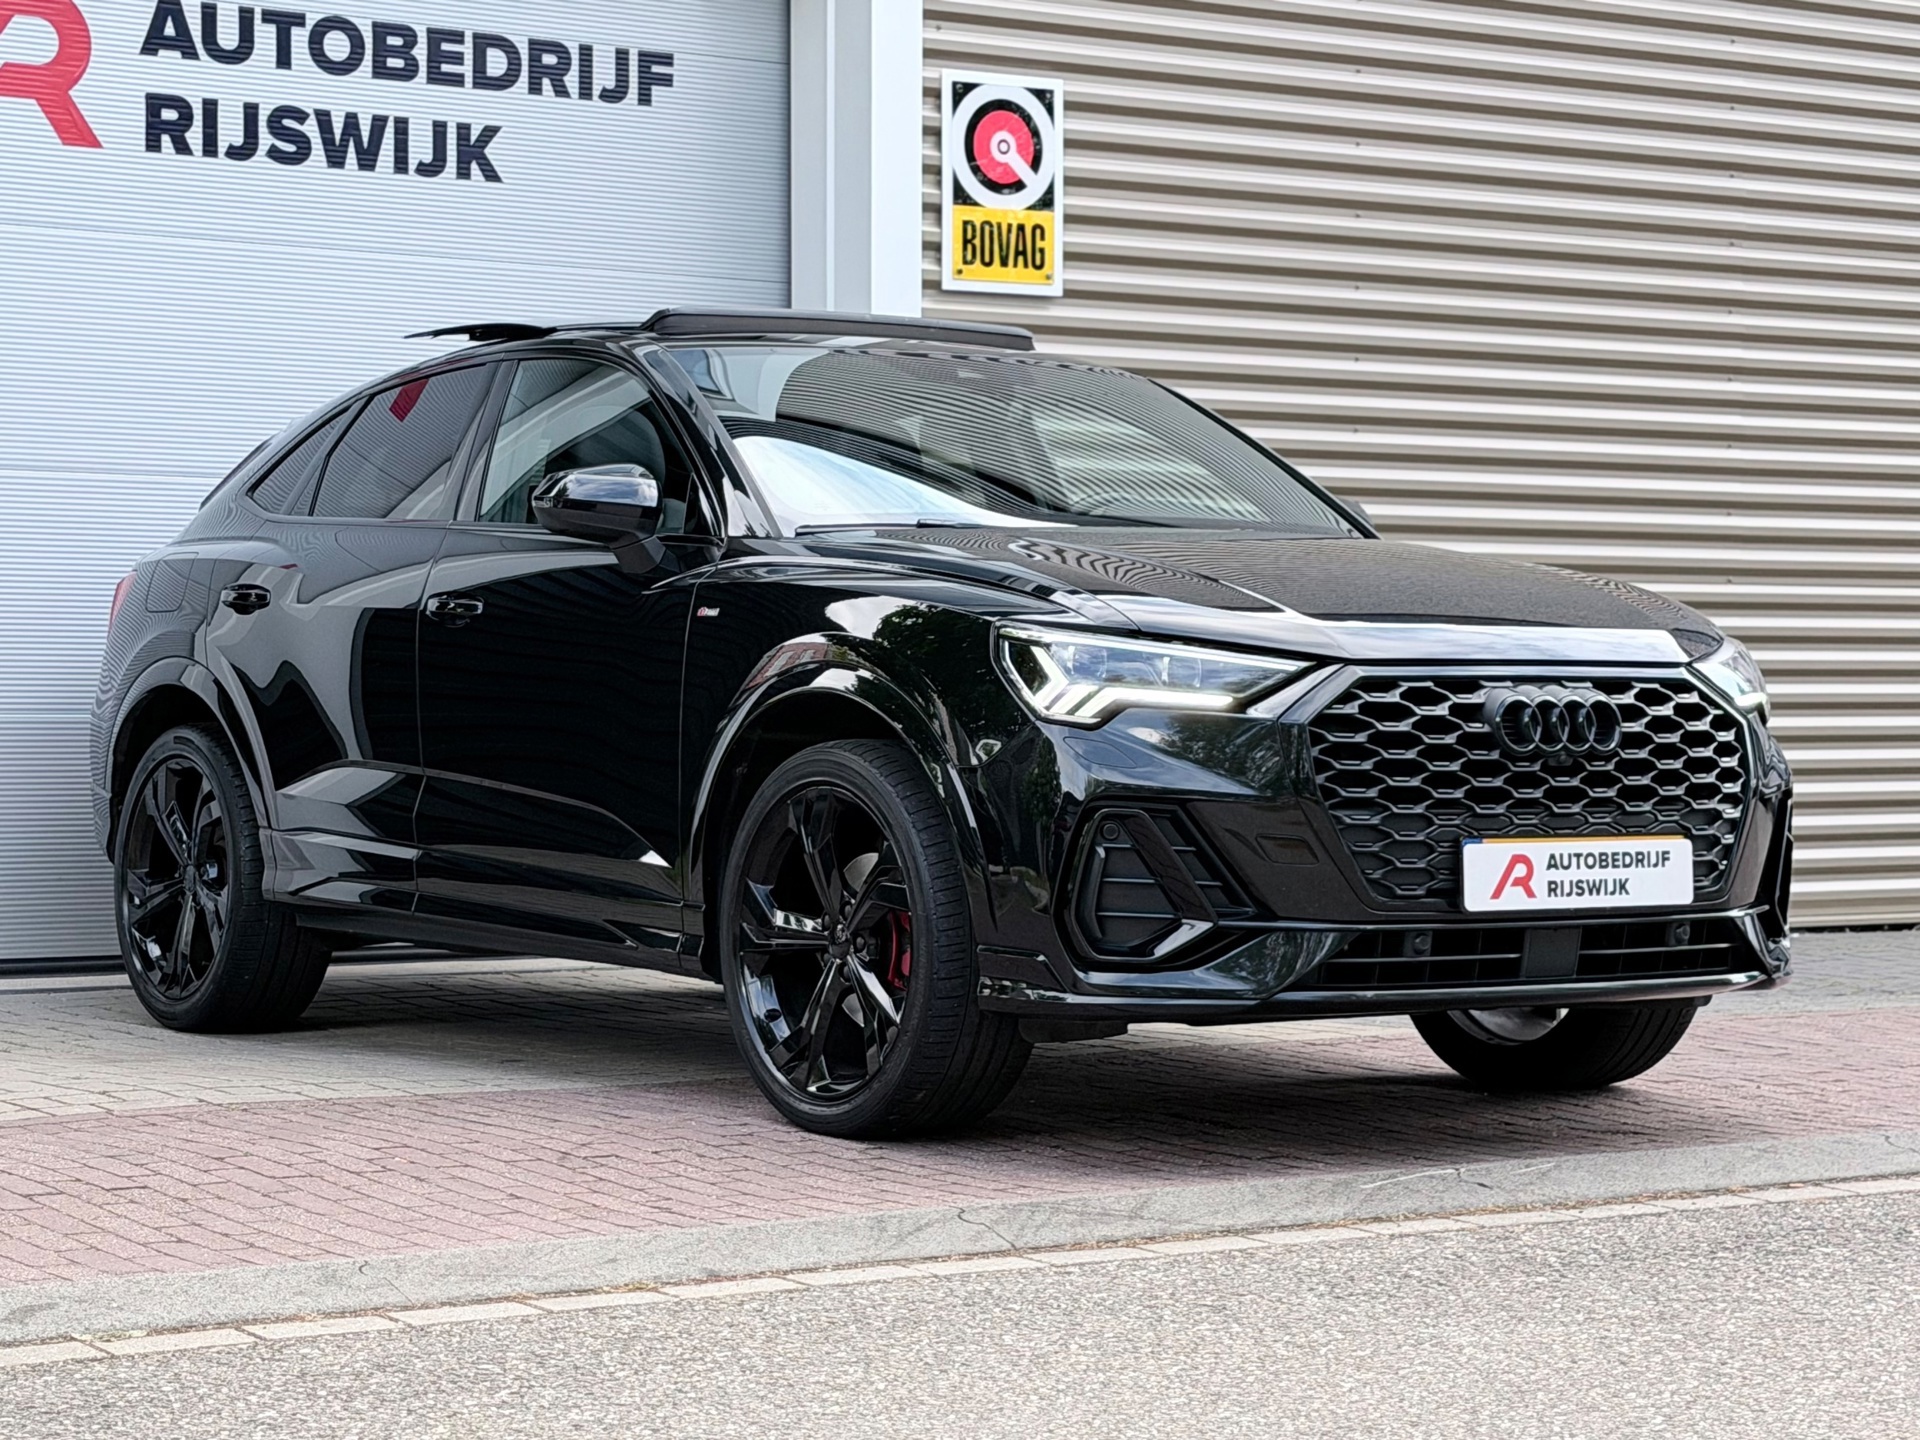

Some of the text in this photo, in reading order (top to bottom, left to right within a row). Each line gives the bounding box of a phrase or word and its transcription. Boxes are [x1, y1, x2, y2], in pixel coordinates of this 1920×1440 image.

[140, 0, 674, 106] AUTOBEDRIJF
[144, 92, 503, 183] RIJSWIJK
[961, 219, 1046, 271] BOVAG
[1545, 850, 1671, 870] AUTOBEDRIJF
[1547, 878, 1630, 897] RIJSWIJK
